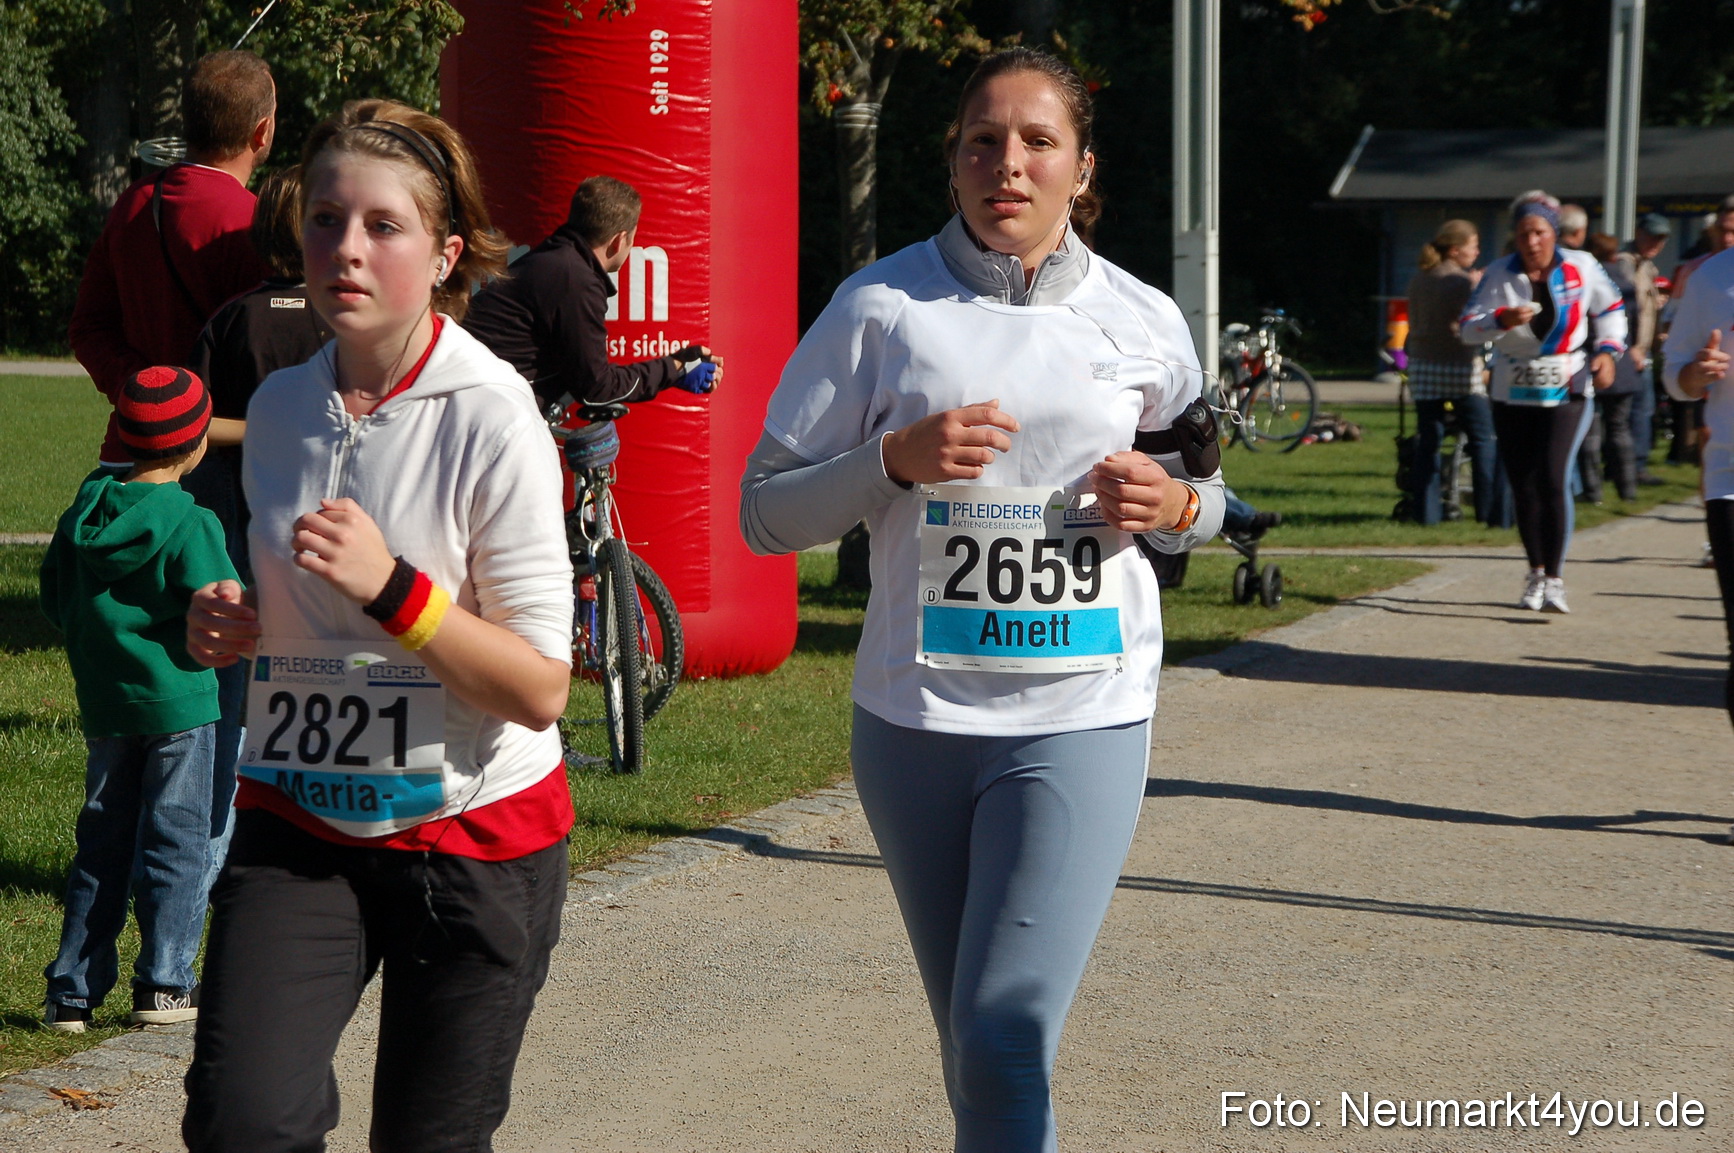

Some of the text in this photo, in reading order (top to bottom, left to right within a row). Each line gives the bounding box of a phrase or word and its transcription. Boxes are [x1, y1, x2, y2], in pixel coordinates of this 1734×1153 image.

[649, 28, 669, 115] Seit 1929
[952, 502, 1042, 519] PFLEIDERER
[952, 521, 1042, 530] AKTIENGESELLSCHAFT
[943, 535, 1102, 604] 2659
[978, 611, 1071, 647] Anett
[273, 656, 345, 675] PFLEIDERER
[367, 665, 426, 679] BOCK
[261, 691, 408, 768] 2821
[276, 770, 393, 812] Maria-
